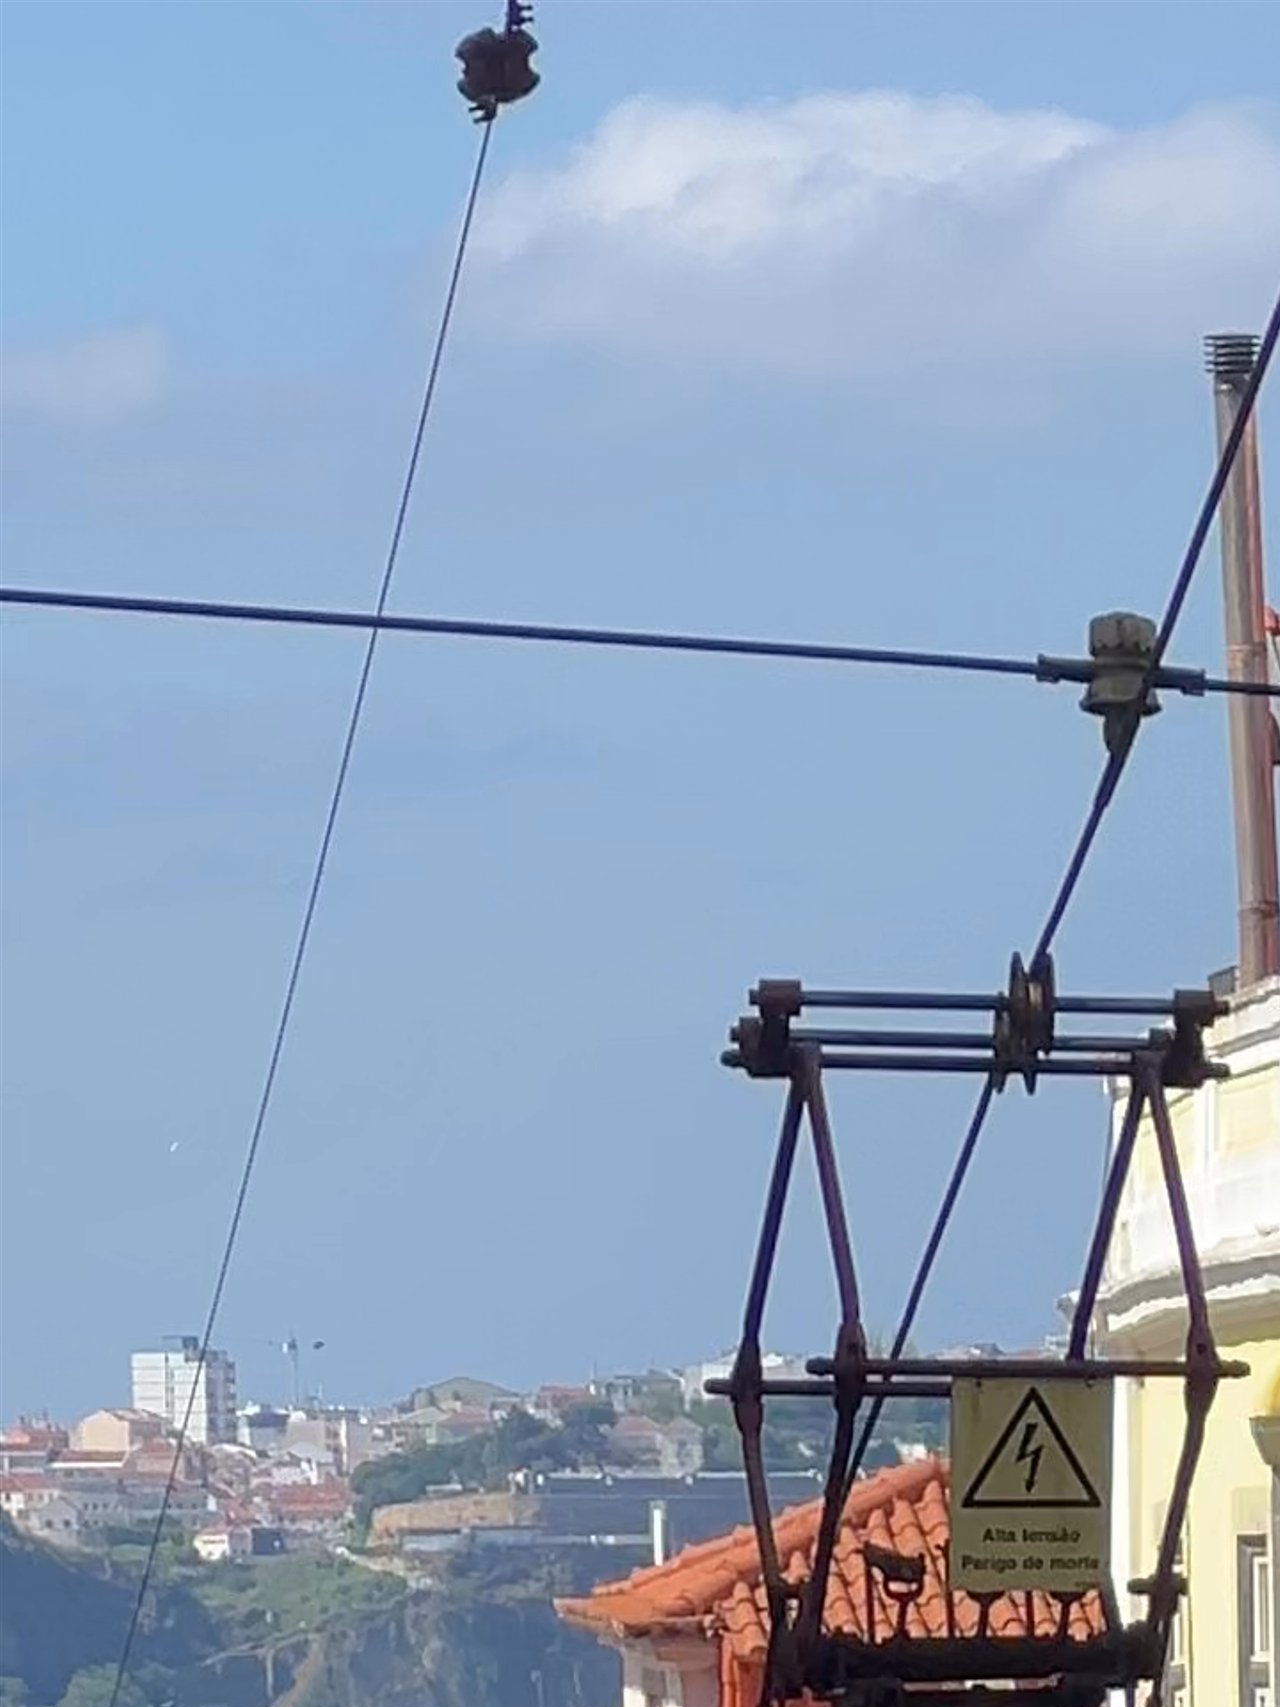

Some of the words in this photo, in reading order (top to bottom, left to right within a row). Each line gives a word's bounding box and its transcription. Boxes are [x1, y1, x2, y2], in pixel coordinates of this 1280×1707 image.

[982, 1527, 1016, 1543] Alta
[961, 1555, 1018, 1573] Perigo
[1023, 1555, 1044, 1570] de
